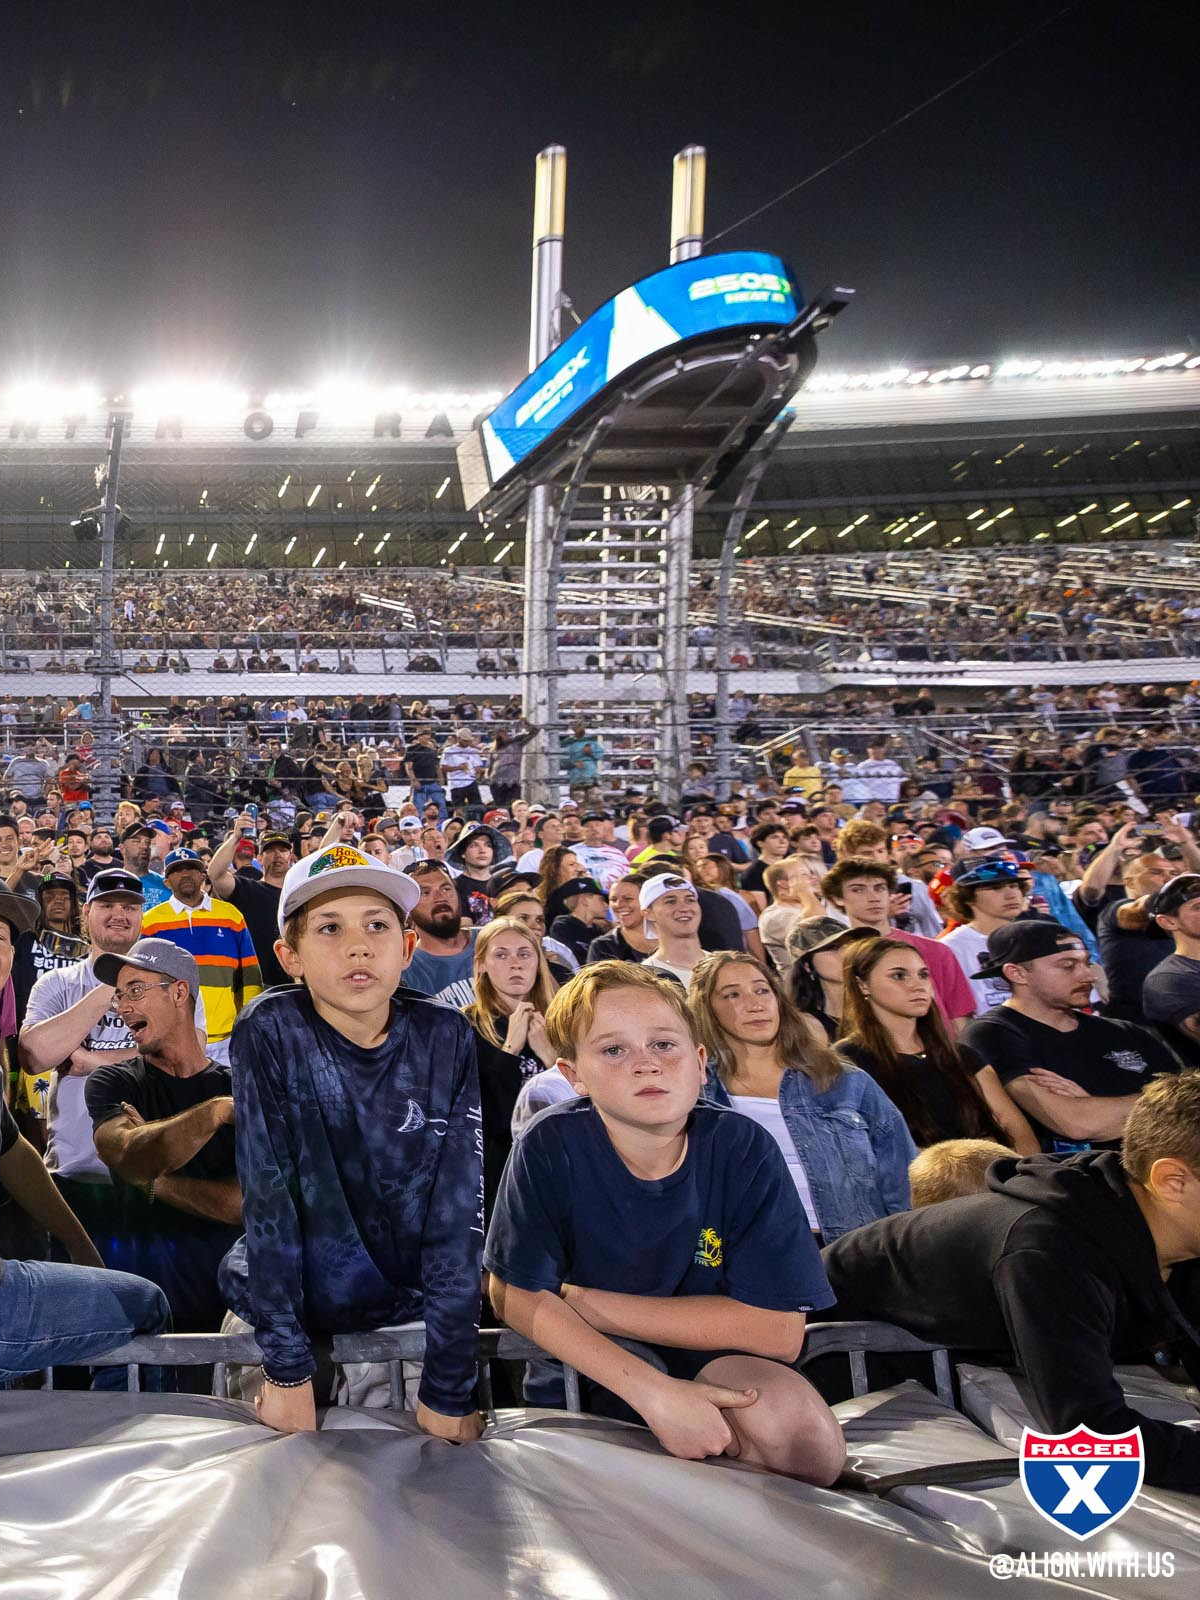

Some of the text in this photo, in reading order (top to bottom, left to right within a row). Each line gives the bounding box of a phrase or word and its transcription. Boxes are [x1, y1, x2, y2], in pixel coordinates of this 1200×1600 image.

[515, 345, 591, 428] 250SX
[244, 411, 320, 440] OF
[338, 855, 358, 864] Pro
